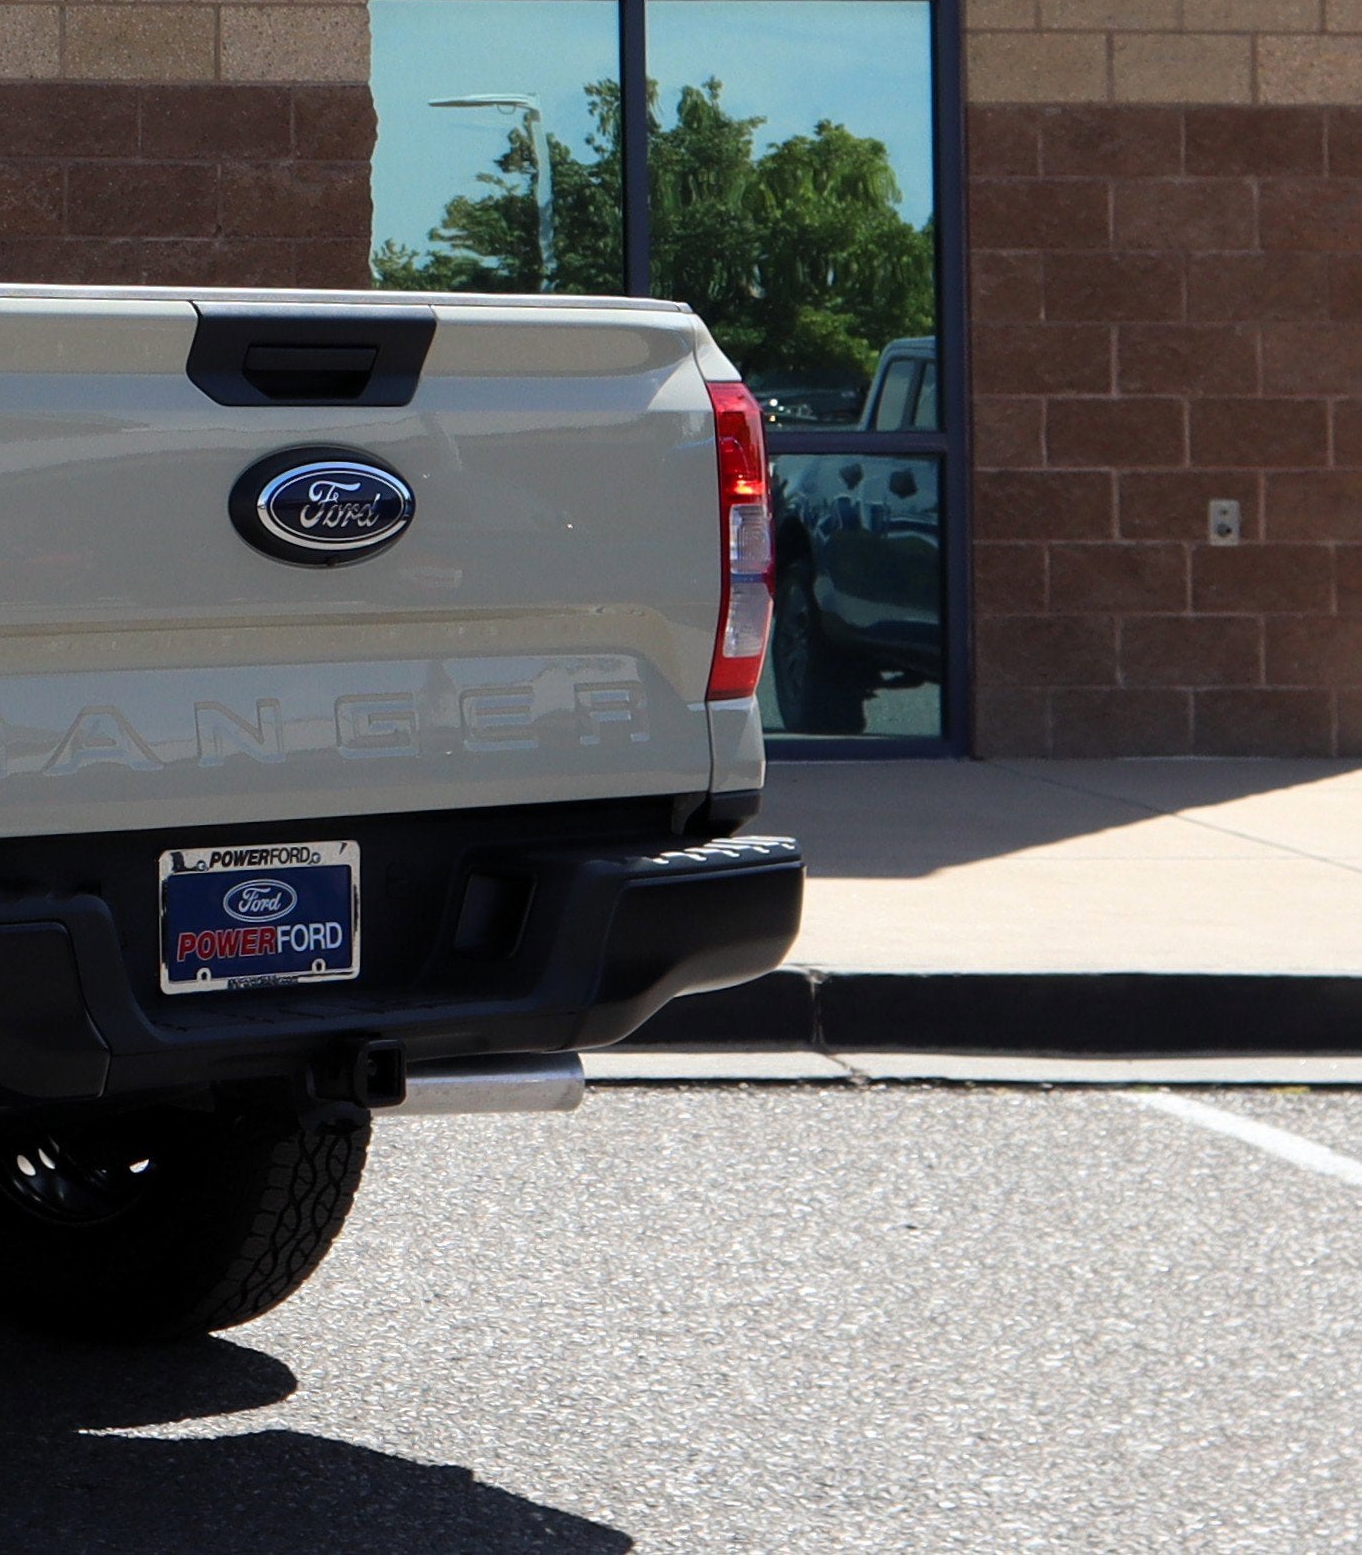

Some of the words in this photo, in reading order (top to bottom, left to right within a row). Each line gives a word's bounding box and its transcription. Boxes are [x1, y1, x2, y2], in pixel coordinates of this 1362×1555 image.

[300, 480, 381, 528] Ford
[209, 846, 311, 869] POWERFORD
[238, 887, 282, 913] Ford
[177, 921, 343, 962] POWERFORD
